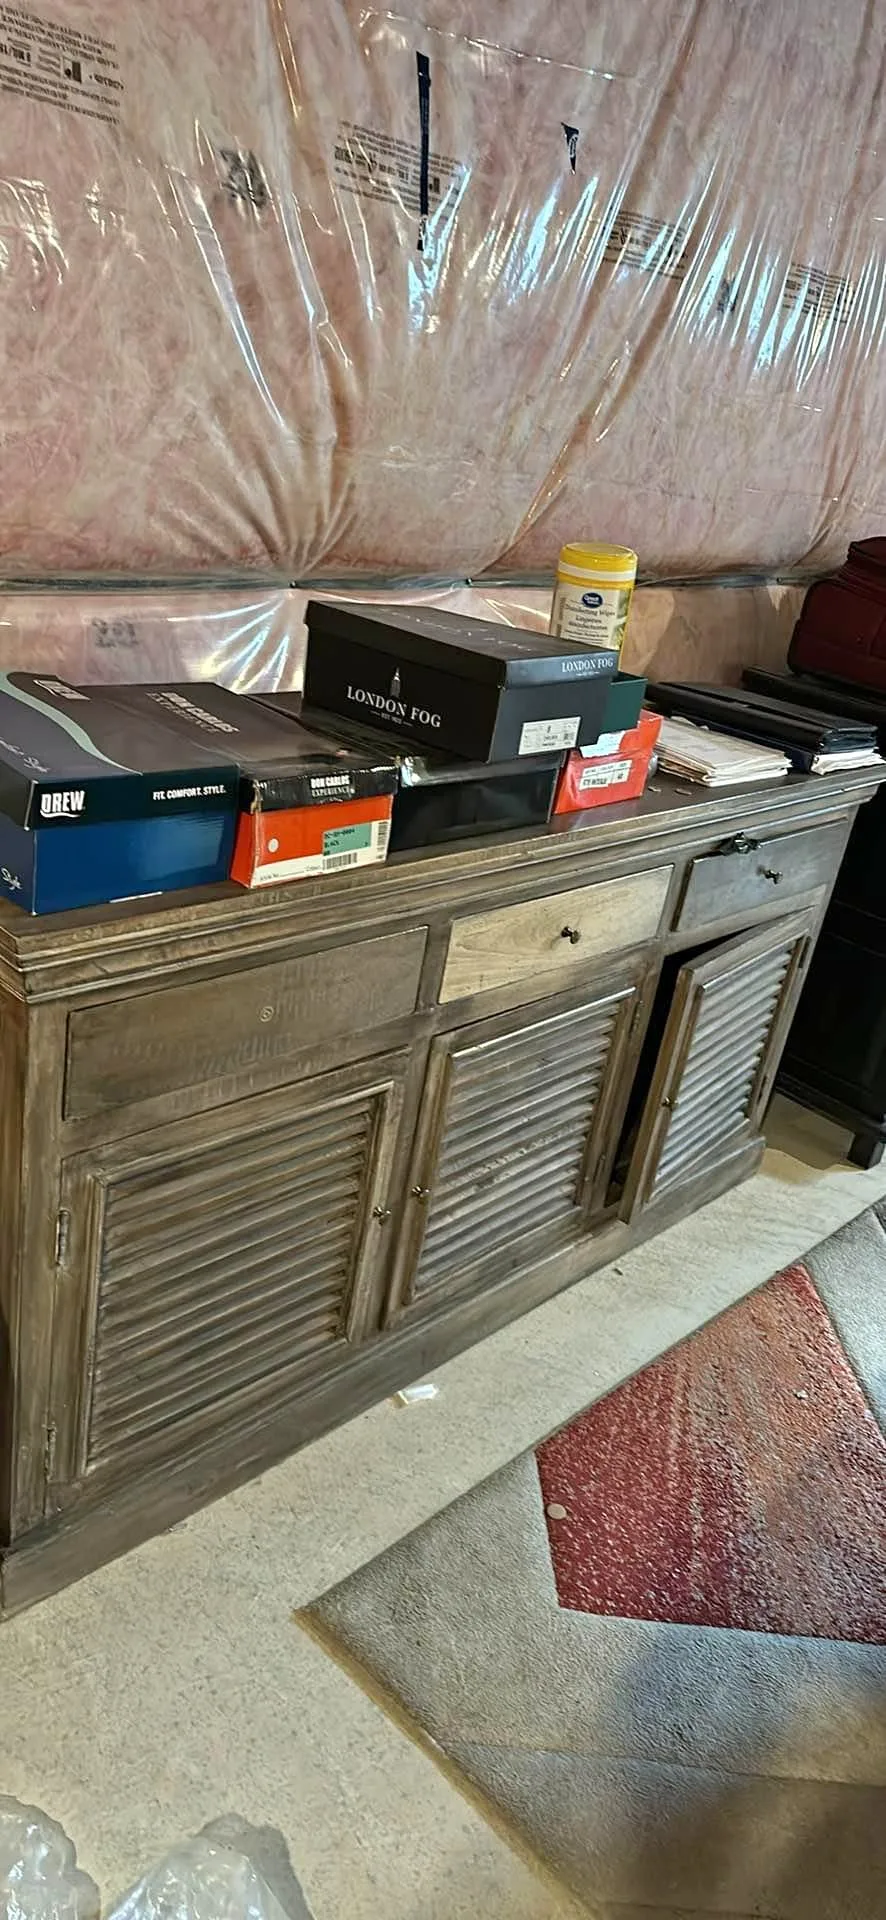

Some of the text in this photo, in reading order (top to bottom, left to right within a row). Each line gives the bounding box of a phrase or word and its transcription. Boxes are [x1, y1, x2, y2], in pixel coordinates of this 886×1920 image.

[561, 657, 614, 673] LONDON FOG
[347, 685, 407, 717] LONDON
[410, 706, 441, 728] FOG
[325, 774, 350, 787] CARLOS
[39, 790, 85, 813] DREW
[203, 784, 227, 796] STYLE.
